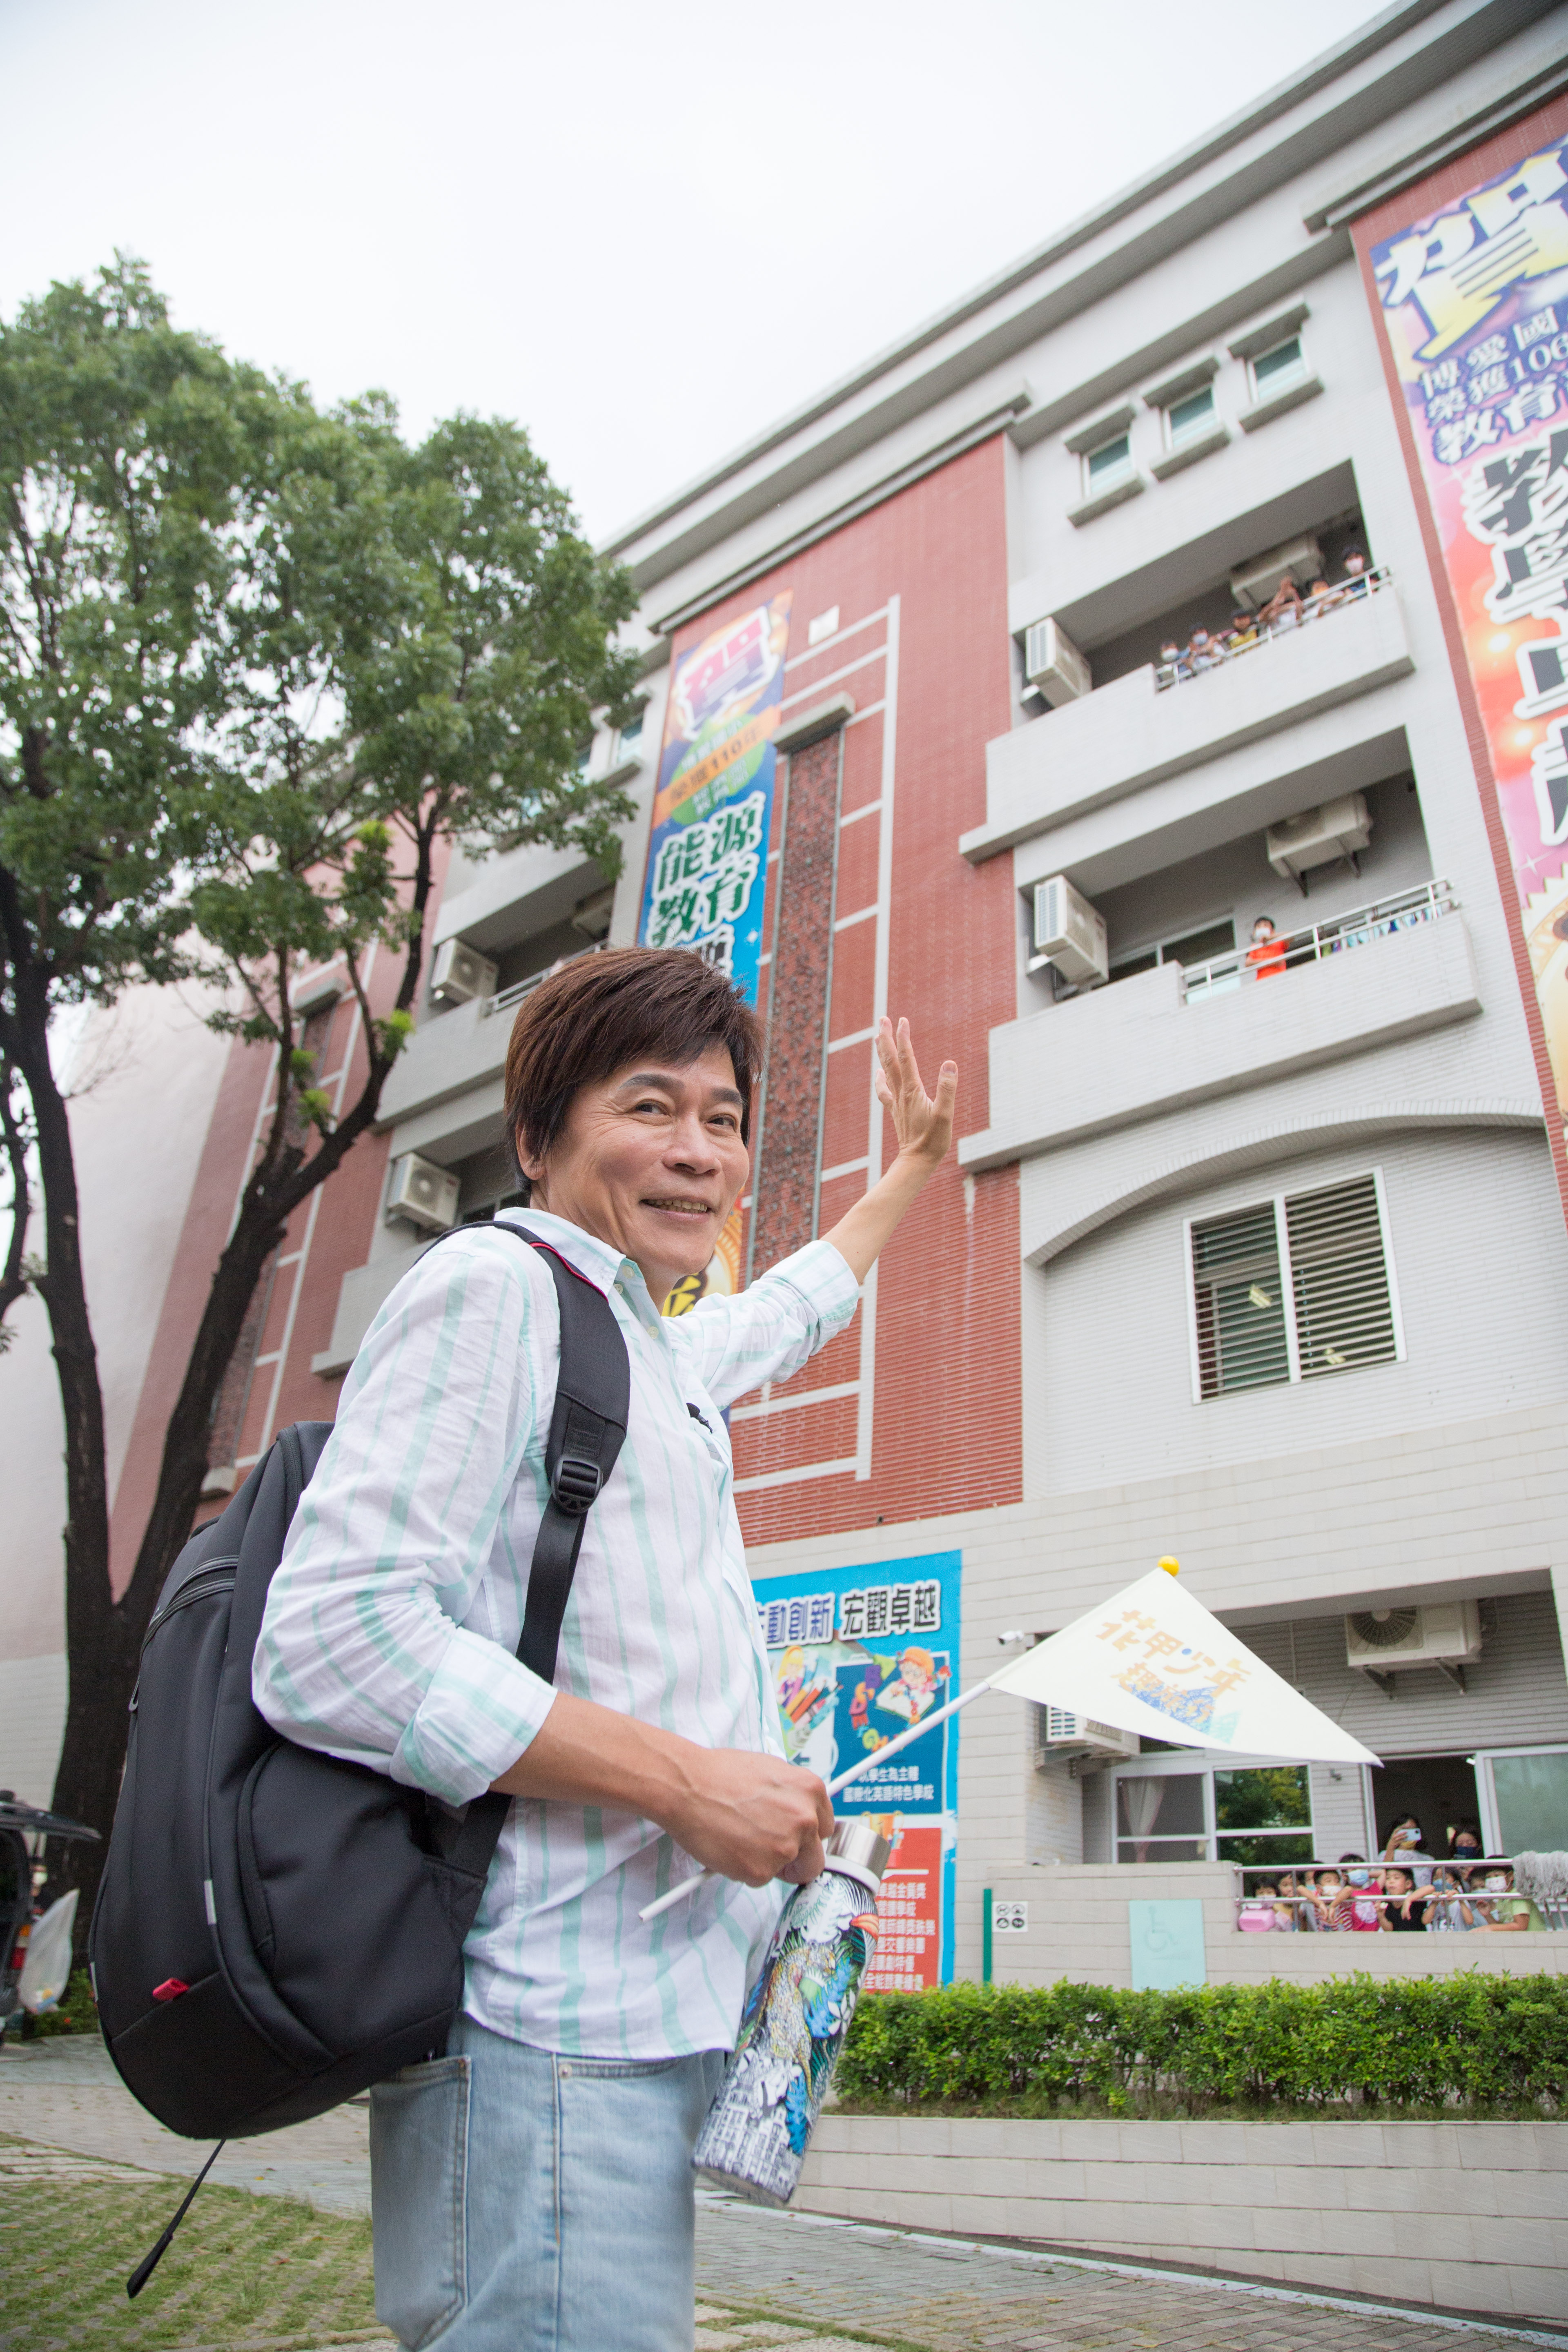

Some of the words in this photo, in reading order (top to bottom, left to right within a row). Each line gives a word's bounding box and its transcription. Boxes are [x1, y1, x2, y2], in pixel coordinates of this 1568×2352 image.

[1435, 371, 1568, 466] 教育
[658, 797, 759, 892] 能源
[758, 1597, 831, 1644] 動創新
[844, 1584, 937, 1635] 宏觀卓越
[1095, 1610, 1253, 1699] 花甲少年
